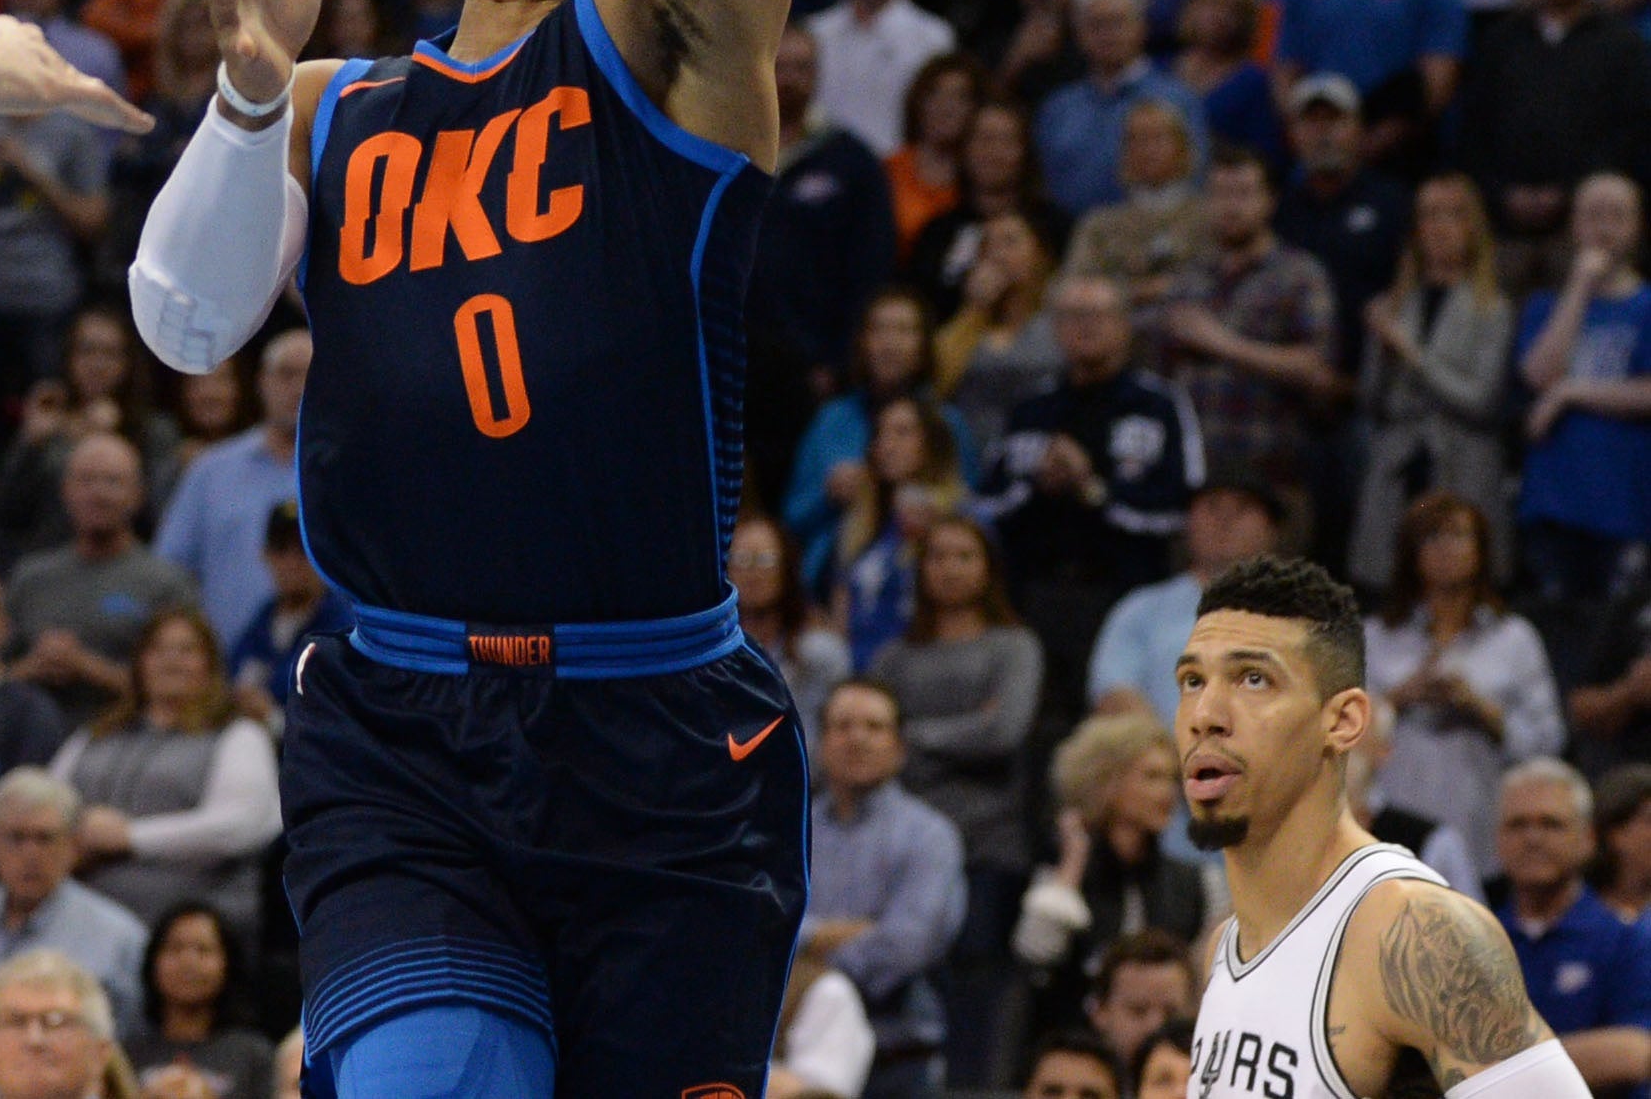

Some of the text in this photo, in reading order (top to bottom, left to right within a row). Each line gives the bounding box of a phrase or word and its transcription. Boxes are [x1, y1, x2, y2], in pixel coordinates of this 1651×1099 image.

[338, 85, 592, 286] OKC
[452, 293, 532, 440] 0
[468, 633, 552, 667] THUNDER
